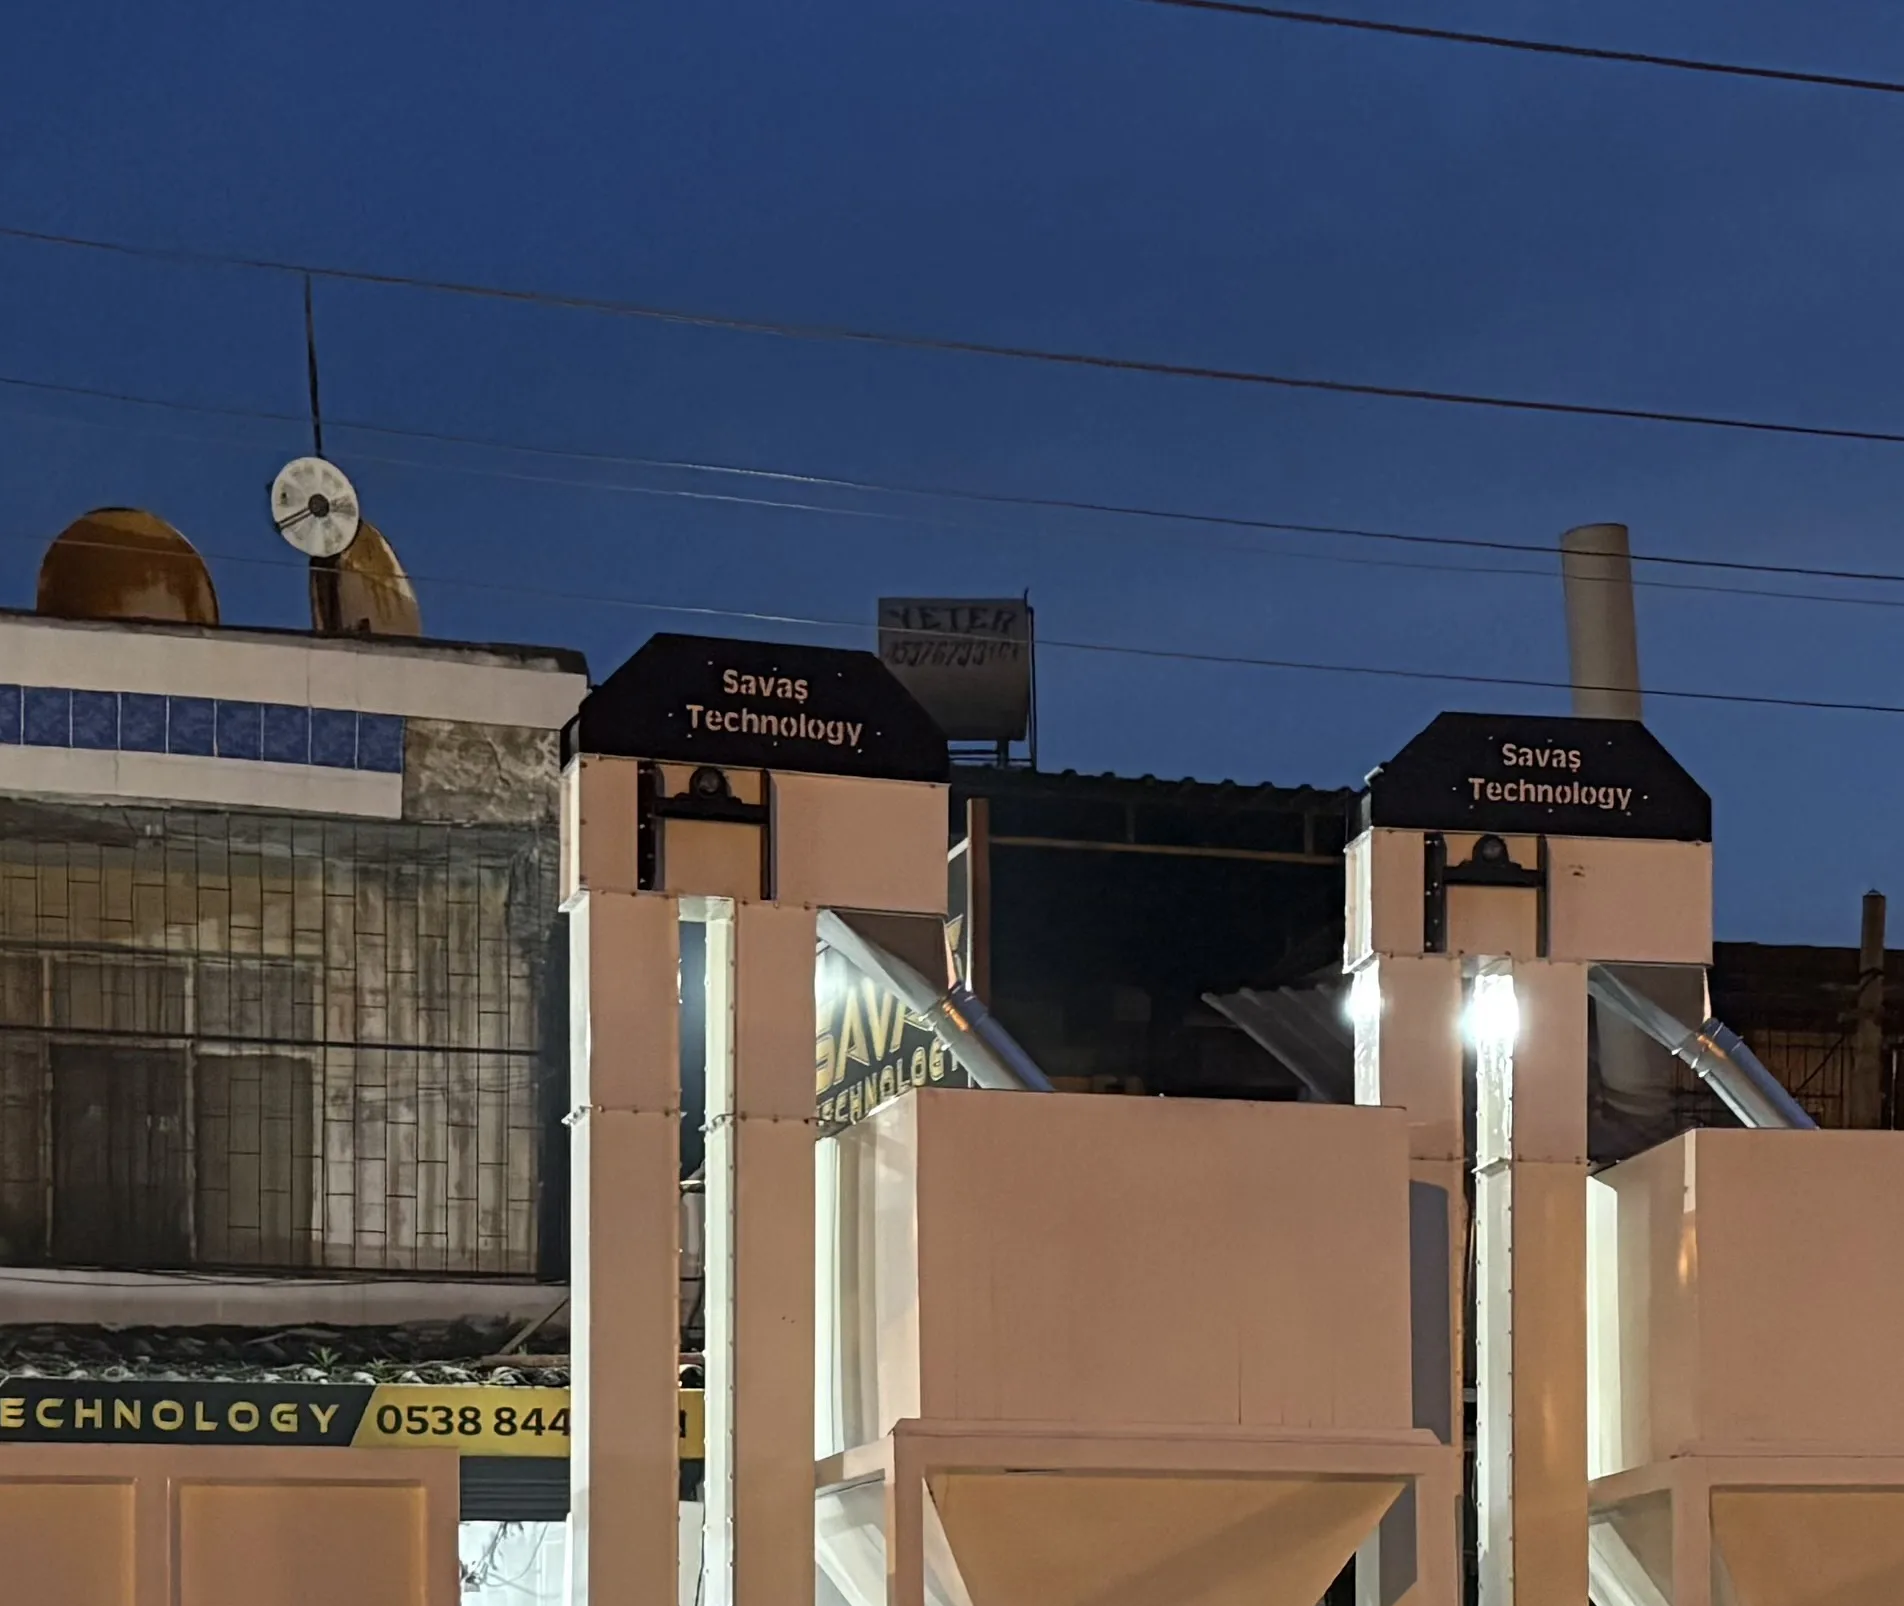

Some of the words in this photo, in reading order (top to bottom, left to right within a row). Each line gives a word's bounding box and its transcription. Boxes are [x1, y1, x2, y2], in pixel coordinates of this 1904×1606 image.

[722, 668, 809, 704] Savaş
[686, 704, 863, 746] Technology
[1501, 742, 1581, 774] Savaş
[1468, 776, 1633, 811] Technology
[377, 1405, 483, 1436] 0538
[493, 1405, 571, 1438] 844
